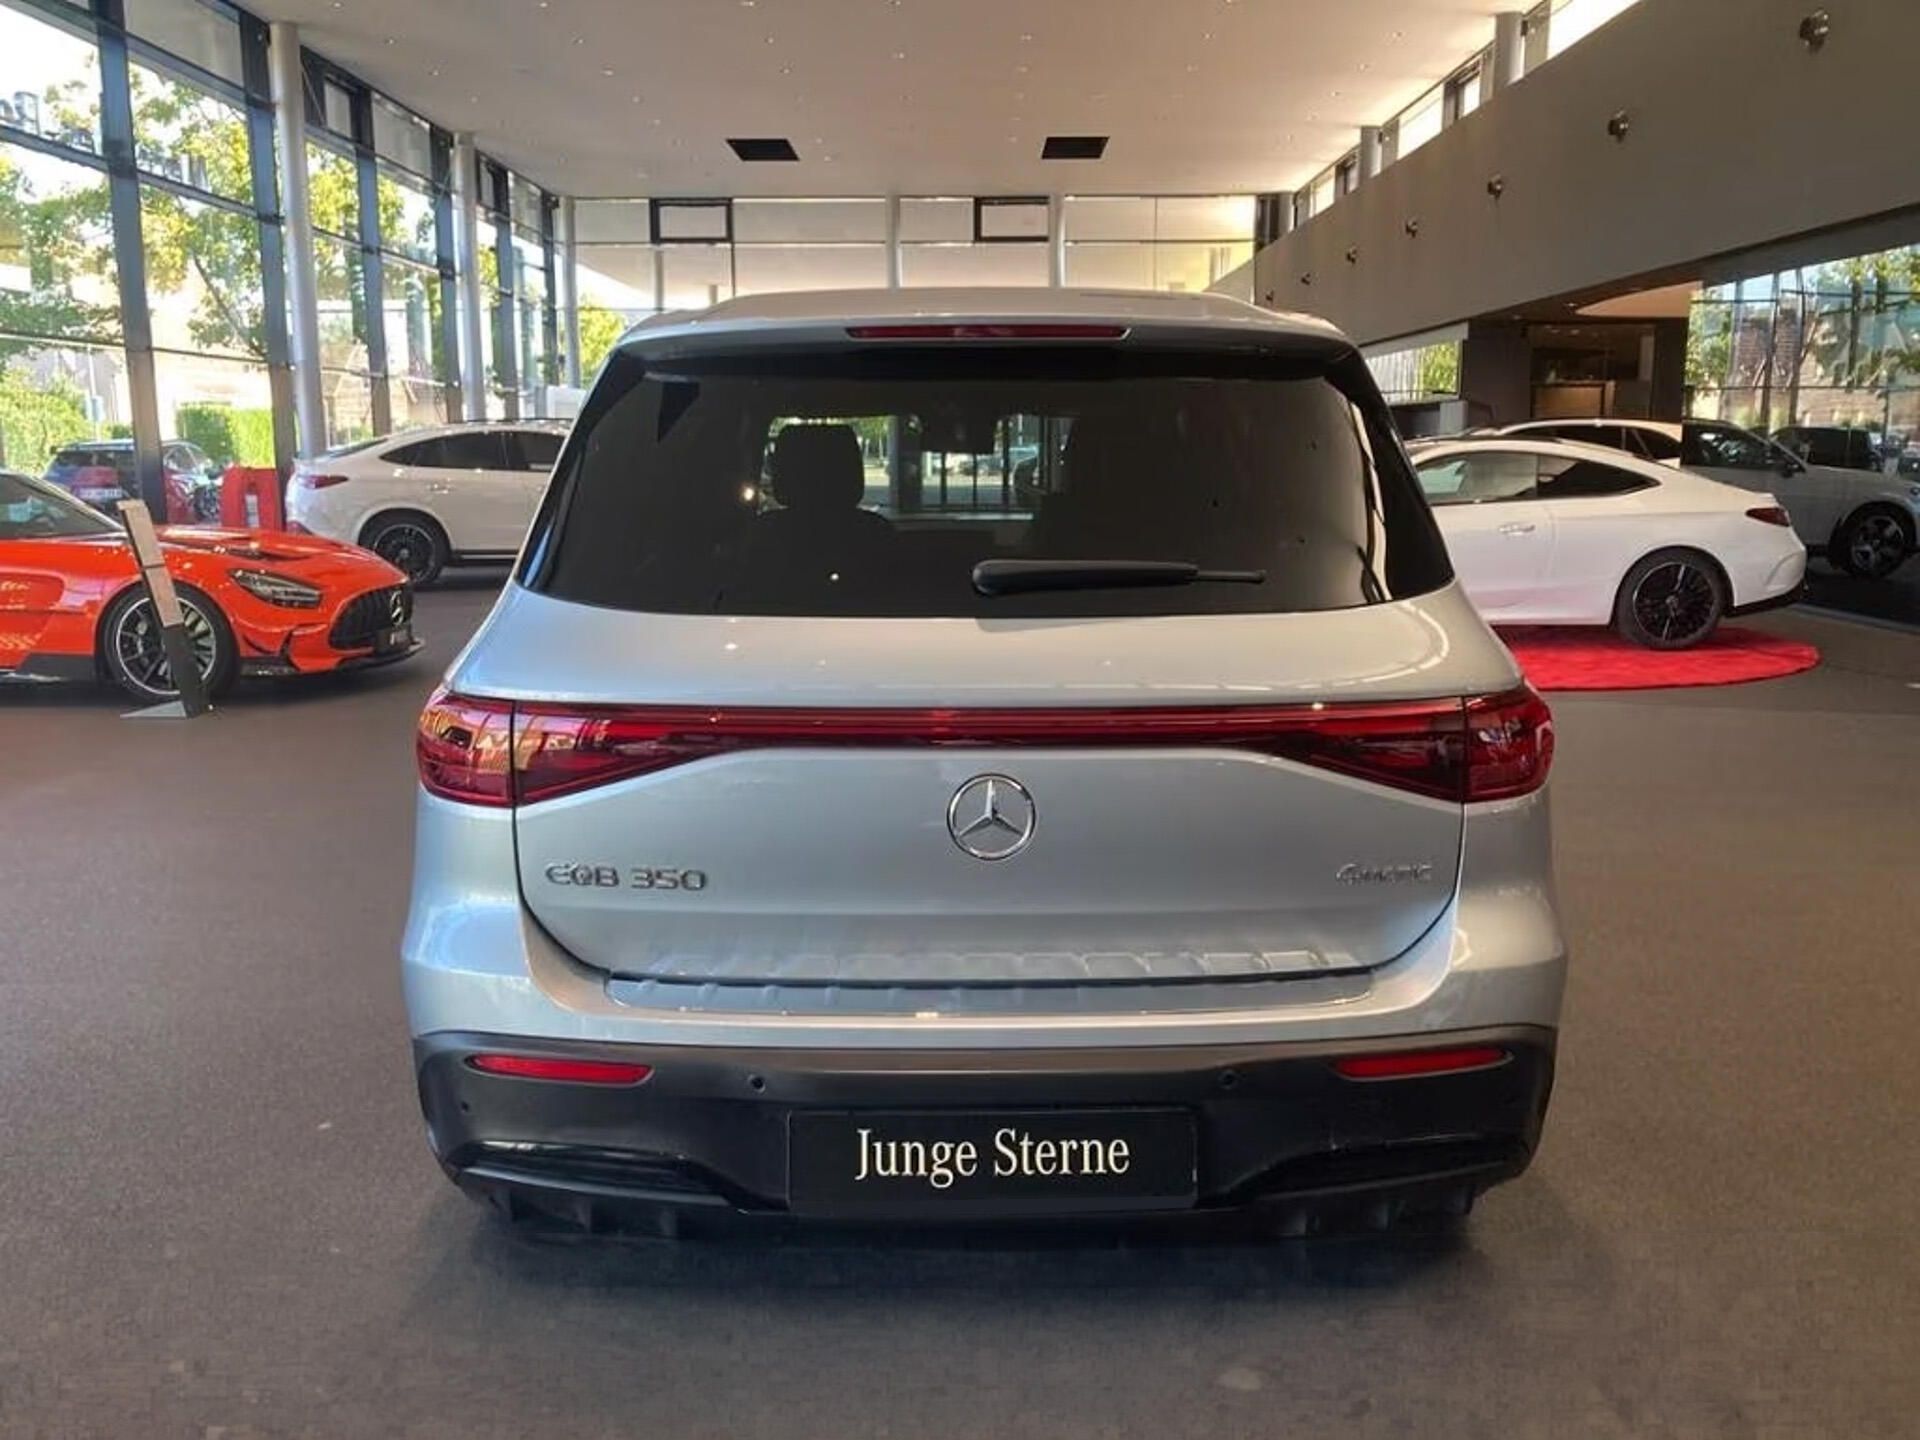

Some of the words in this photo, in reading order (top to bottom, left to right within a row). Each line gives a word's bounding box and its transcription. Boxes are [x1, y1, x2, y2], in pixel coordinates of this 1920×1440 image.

[546, 862, 620, 888] EQB
[630, 867, 706, 891] 350
[853, 1127, 978, 1189] Junge
[993, 1127, 1131, 1177] Sterne
